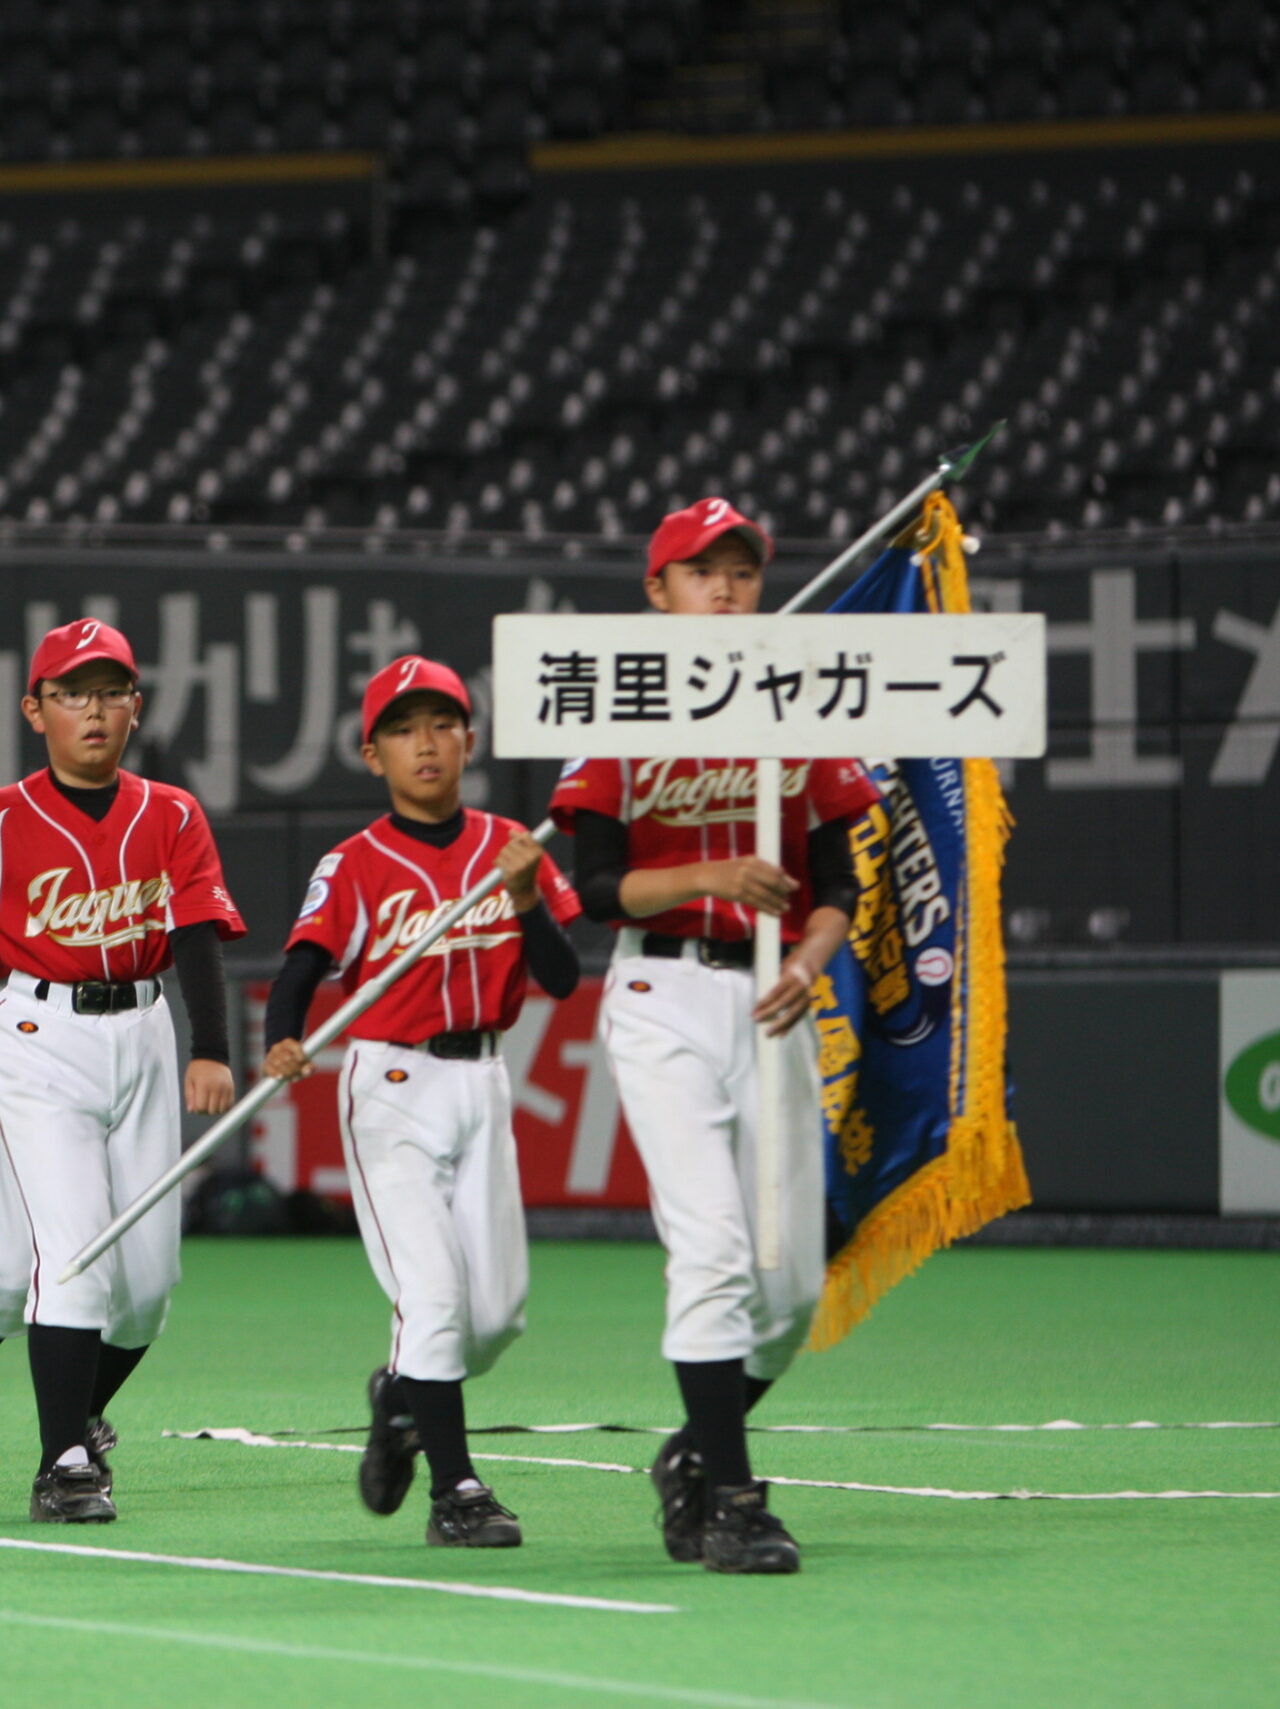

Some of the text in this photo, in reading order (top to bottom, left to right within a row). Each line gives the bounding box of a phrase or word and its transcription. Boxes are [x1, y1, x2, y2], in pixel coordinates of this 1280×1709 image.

[537, 650, 1007, 725] 清里ジャガーズ
